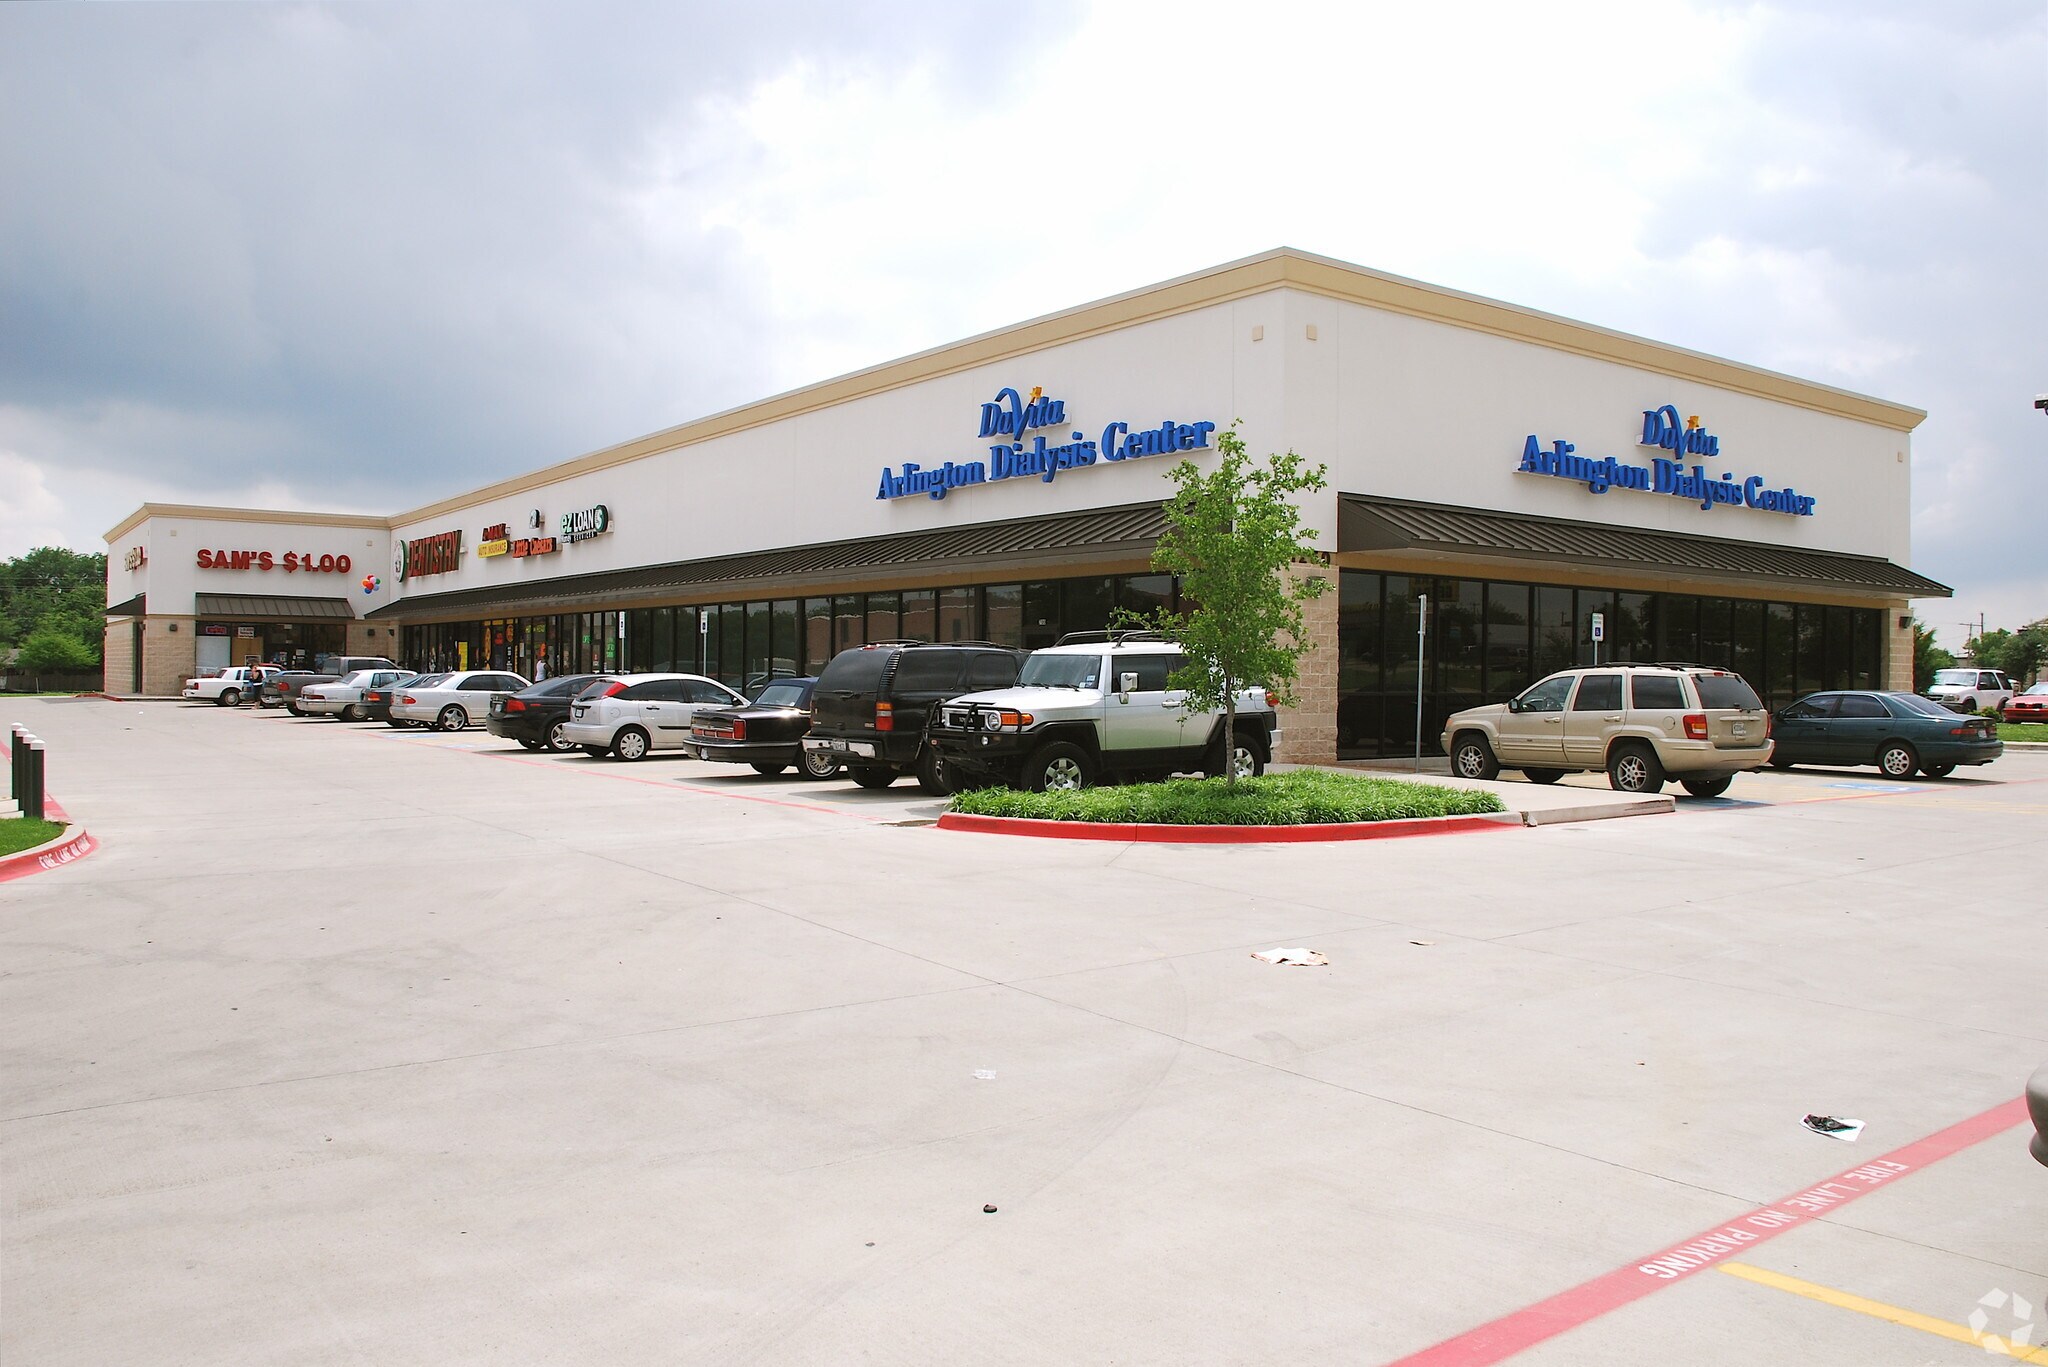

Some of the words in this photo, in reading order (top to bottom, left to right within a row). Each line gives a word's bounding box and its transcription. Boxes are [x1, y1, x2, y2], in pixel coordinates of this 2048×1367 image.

[978, 387, 1067, 441] DaVita
[1642, 404, 1720, 460] DaVita
[876, 462, 986, 501] Arlington
[989, 431, 1097, 483] Dialysis
[1101, 420, 1215, 461] Center
[1518, 435, 1650, 494] Arlington
[1652, 458, 1743, 510] Dialysis
[1744, 476, 1815, 516] Center
[197, 549, 274, 571] SAM'S
[283, 551, 353, 574] $1.00
[408, 530, 462, 577] DENTISTRY
[512, 539, 530, 558] Little
[530, 537, 556, 555] Caesars
[1844, 1160, 1910, 1184] FIRE
[1746, 1209, 1799, 1228] NO
[1784, 1182, 1860, 1212] LANE
[1638, 1227, 1760, 1279] PARKING
